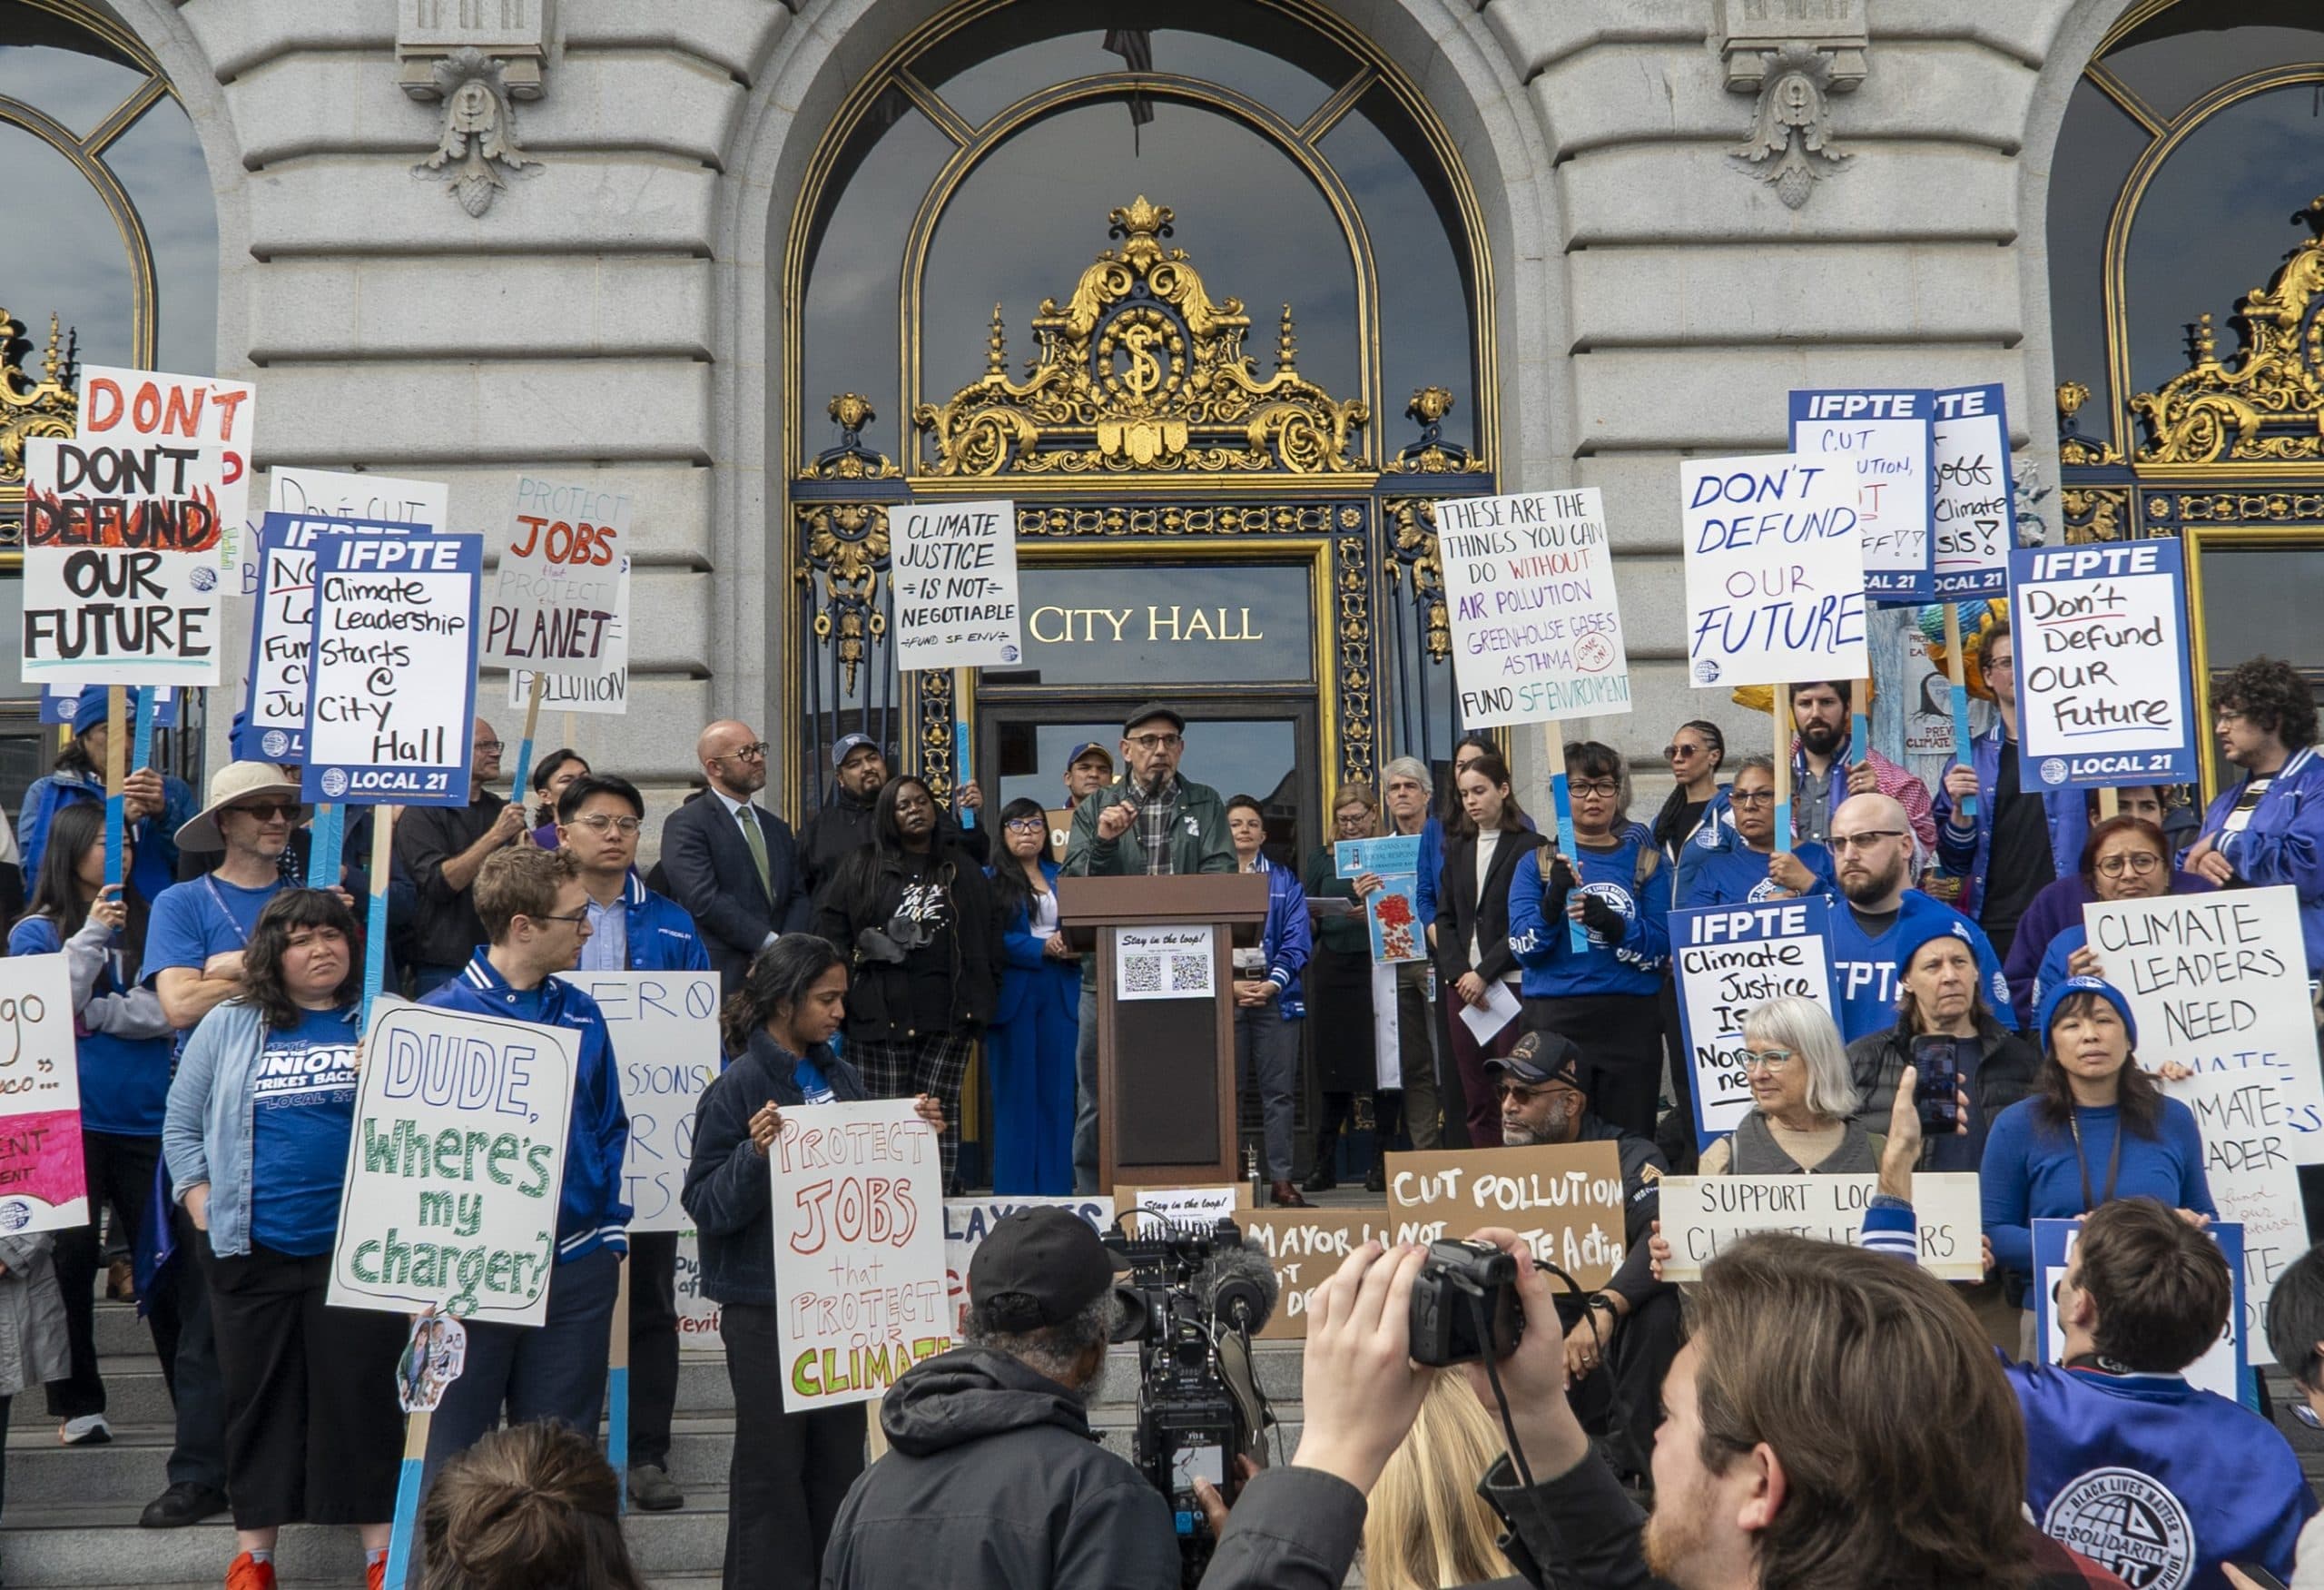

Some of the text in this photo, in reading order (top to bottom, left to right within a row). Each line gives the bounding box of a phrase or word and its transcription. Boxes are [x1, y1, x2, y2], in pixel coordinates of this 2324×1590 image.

[88, 378, 248, 442] DON'T
[1808, 394, 1915, 419] IFPTE
[57, 443, 199, 494] DON'T
[1689, 464, 1825, 509] DON'T
[517, 478, 631, 522] PROTECT
[1438, 493, 1586, 530] THESE ARE THE
[1935, 496, 2006, 522] Climate
[26, 497, 212, 548] DEFUND
[510, 515, 617, 566] JOBS
[908, 513, 1000, 538] CLIMATE
[1443, 522, 1604, 558] THINGS YOU CAN
[1696, 507, 1856, 554] DEFUND
[337, 540, 460, 570] IFPTE
[900, 543, 995, 569] JUSTICE
[1468, 548, 1590, 584] DO WITHOUT
[2032, 546, 2158, 580] IFPTE
[64, 549, 168, 599] OUR
[324, 577, 431, 604] Climate
[498, 570, 608, 601] PROTECT
[920, 578, 990, 599] IS NOT
[1726, 565, 1814, 598] OUR
[1896, 575, 1915, 588] 21
[1935, 572, 2003, 592] OCAL 21
[901, 604, 1016, 628] NEGOTIABLE
[1458, 579, 1592, 621] AIR POLLUTION
[2027, 583, 2127, 620] Don't
[25, 604, 211, 659] FUTURE
[335, 607, 465, 636] Leadership
[486, 606, 614, 658] PLANET
[1029, 606, 1264, 643] CITY HALL
[1467, 612, 1617, 655] GREENHOUSE GASES
[1691, 592, 1865, 657] FUTURE
[2043, 616, 2163, 653] Defund
[320, 637, 410, 667] Starts
[1502, 649, 1572, 676] ASTHMA
[367, 667, 397, 696] @
[318, 696, 392, 732] City
[1462, 686, 1512, 717] FUND
[2053, 696, 2172, 732] Future
[372, 726, 444, 764] Hall
[350, 772, 448, 790] LOCAL 21
[2072, 754, 2172, 775] LOCAL 21
[1122, 932, 1206, 947] Stay in the loop!
[1691, 905, 1807, 944] IFPTE
[2099, 904, 2261, 952] CLIMATE
[1684, 943, 1804, 974] Climate
[2131, 949, 2286, 995] LEADERS
[1720, 973, 1818, 1003] Justice
[2163, 1000, 2257, 1046] NEED
[313, 1072, 356, 1084] BACK
[384, 1028, 539, 1124] DUDE,
[267, 1092, 326, 1110] LOCAL
[363, 1118, 554, 1199] Where's
[779, 1118, 929, 1174] PROTECT
[1144, 1197, 1227, 1212] Stay in the loop!
[1393, 1168, 1463, 1207] CUT
[1472, 1170, 1623, 1211] POLLUTION
[1701, 1183, 1874, 1213] SUPPORT LOC
[419, 1190, 483, 1237] my
[790, 1177, 917, 1255] JOBS
[1248, 1222, 1352, 1258] MAYOR
[350, 1228, 553, 1317] charger?
[828, 1254, 883, 1287] that
[791, 1279, 940, 1339] PROTECT
[851, 1328, 904, 1350] OUR
[2071, 1477, 2179, 1533] BLACK LIVES MATTER
[2068, 1526, 2170, 1564] SOLIDARITY
